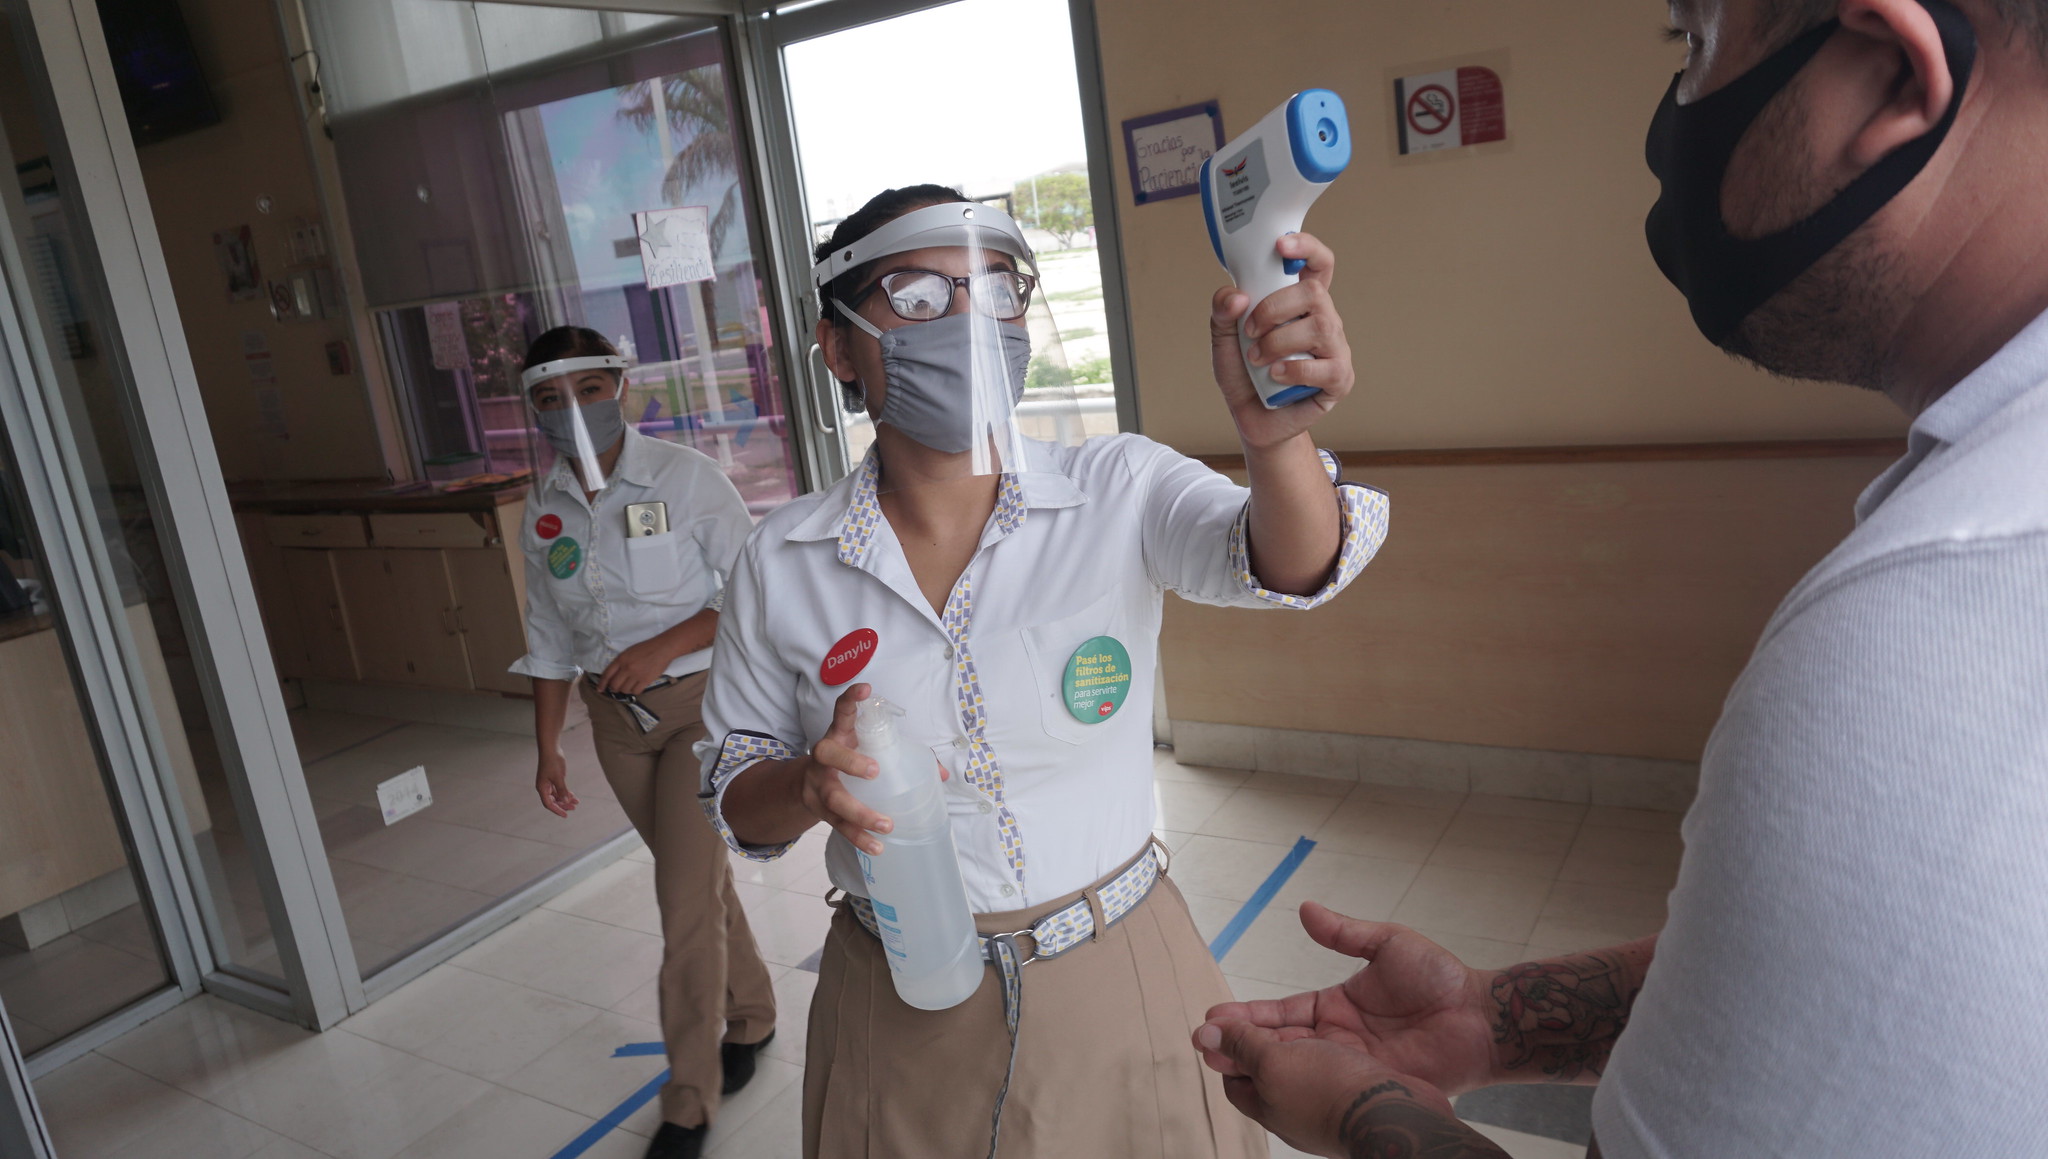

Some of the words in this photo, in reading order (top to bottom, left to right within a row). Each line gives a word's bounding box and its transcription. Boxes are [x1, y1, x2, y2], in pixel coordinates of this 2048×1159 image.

[1135, 135, 1184, 158] Gracias
[1181, 145, 1197, 162] por
[1139, 162, 1201, 191] Pacienci
[827, 640, 871, 669] Danylu
[1099, 653, 1112, 663] los
[1075, 666, 1103, 677] filtros
[1105, 664, 1116, 673] de
[1075, 673, 1129, 688] sanitización
[1074, 688, 1090, 700] para
[1091, 686, 1117, 697] servirte
[1073, 699, 1095, 710] mejor
